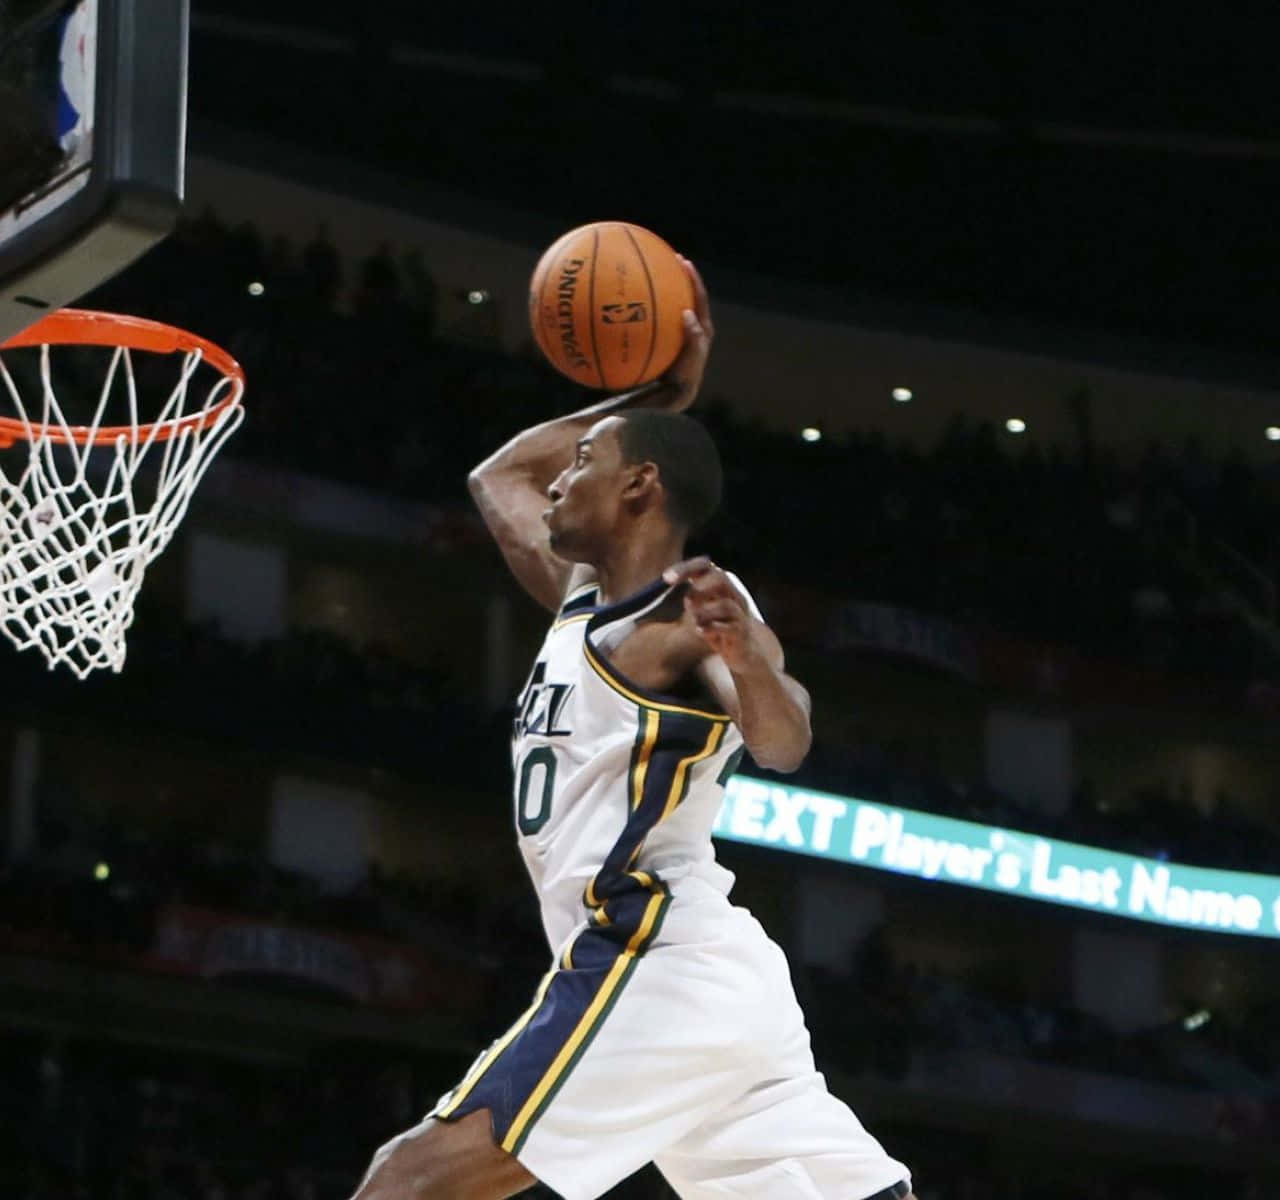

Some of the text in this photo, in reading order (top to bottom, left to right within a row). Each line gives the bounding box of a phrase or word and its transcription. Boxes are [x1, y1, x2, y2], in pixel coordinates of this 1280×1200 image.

[714, 777, 847, 852] EXT
[850, 804, 1021, 889] Player's
[1029, 839, 1122, 909] Last
[1127, 861, 1263, 931] Name
